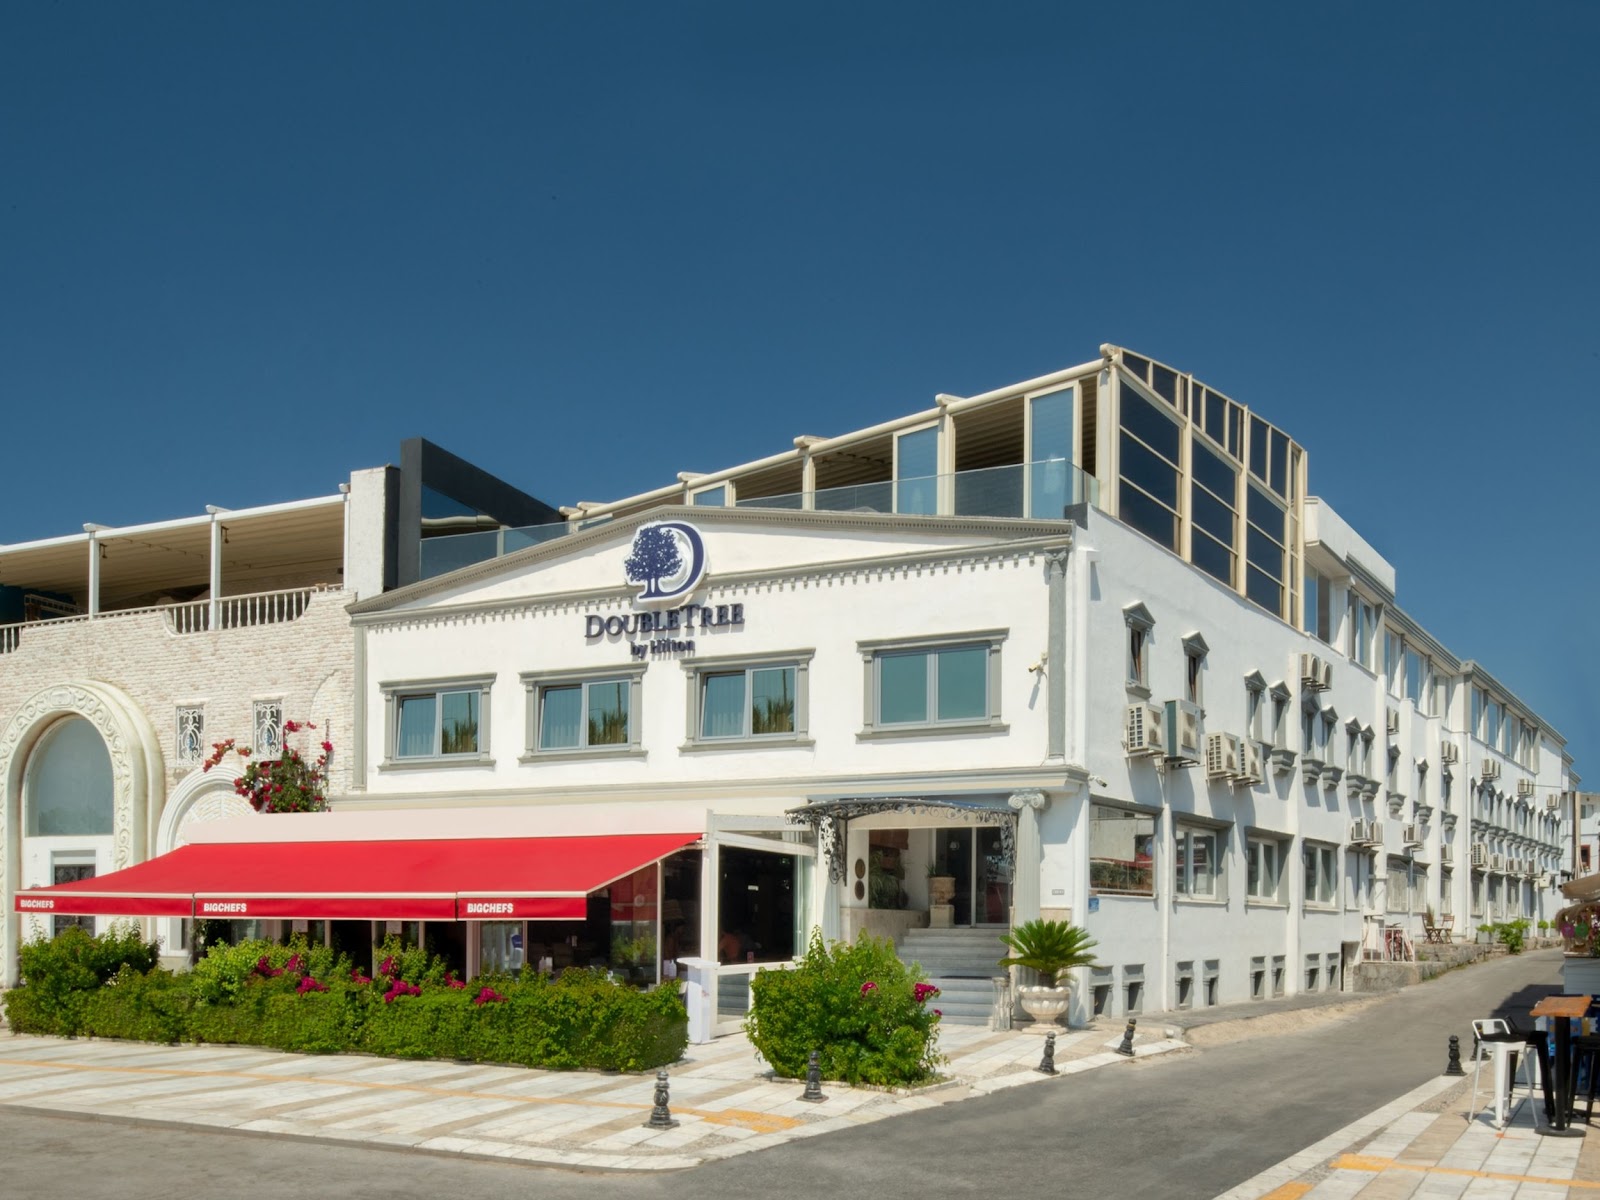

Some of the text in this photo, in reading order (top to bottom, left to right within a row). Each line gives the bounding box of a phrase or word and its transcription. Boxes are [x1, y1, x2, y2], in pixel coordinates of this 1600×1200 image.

[630, 638, 695, 659] by Hilton
[20, 899, 55, 909] BIGCHEFS
[203, 902, 247, 913] BIGCHEFS
[467, 902, 514, 913] BIGCHEFS
